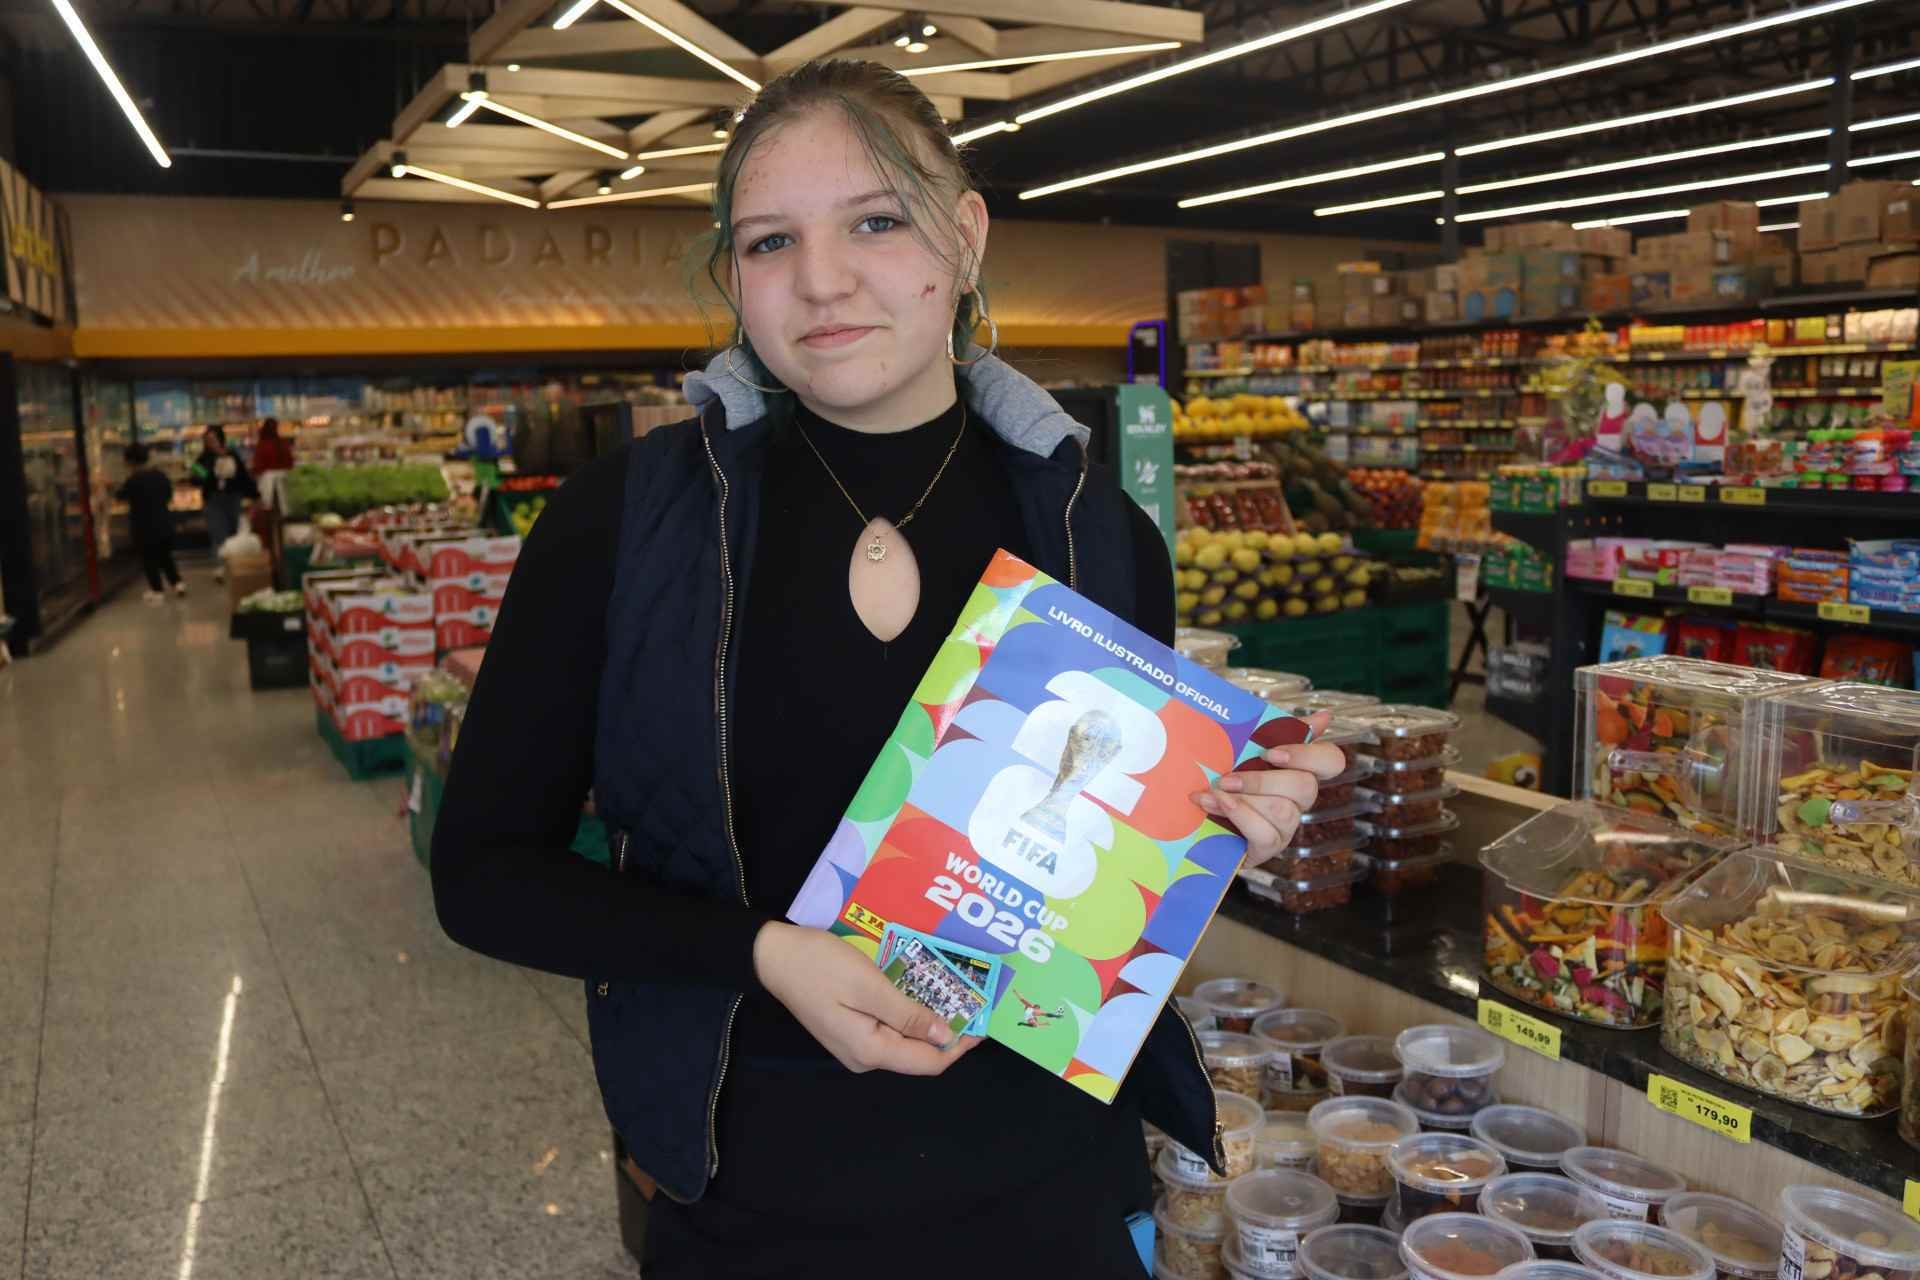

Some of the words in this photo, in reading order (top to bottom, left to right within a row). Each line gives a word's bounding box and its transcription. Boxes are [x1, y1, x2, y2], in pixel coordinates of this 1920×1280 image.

[369, 222, 688, 268] PADARIA
[1048, 606, 1094, 638] LIVRO
[1093, 633, 1174, 686] ILUSTRADO
[1175, 682, 1231, 720] OFICIAL
[1001, 828, 1058, 875] FIFA
[924, 875, 1056, 964] 2026
[945, 851, 1023, 908] WORLD
[1023, 899, 1069, 931] CUP
[1696, 1104, 1738, 1128] 179,90
